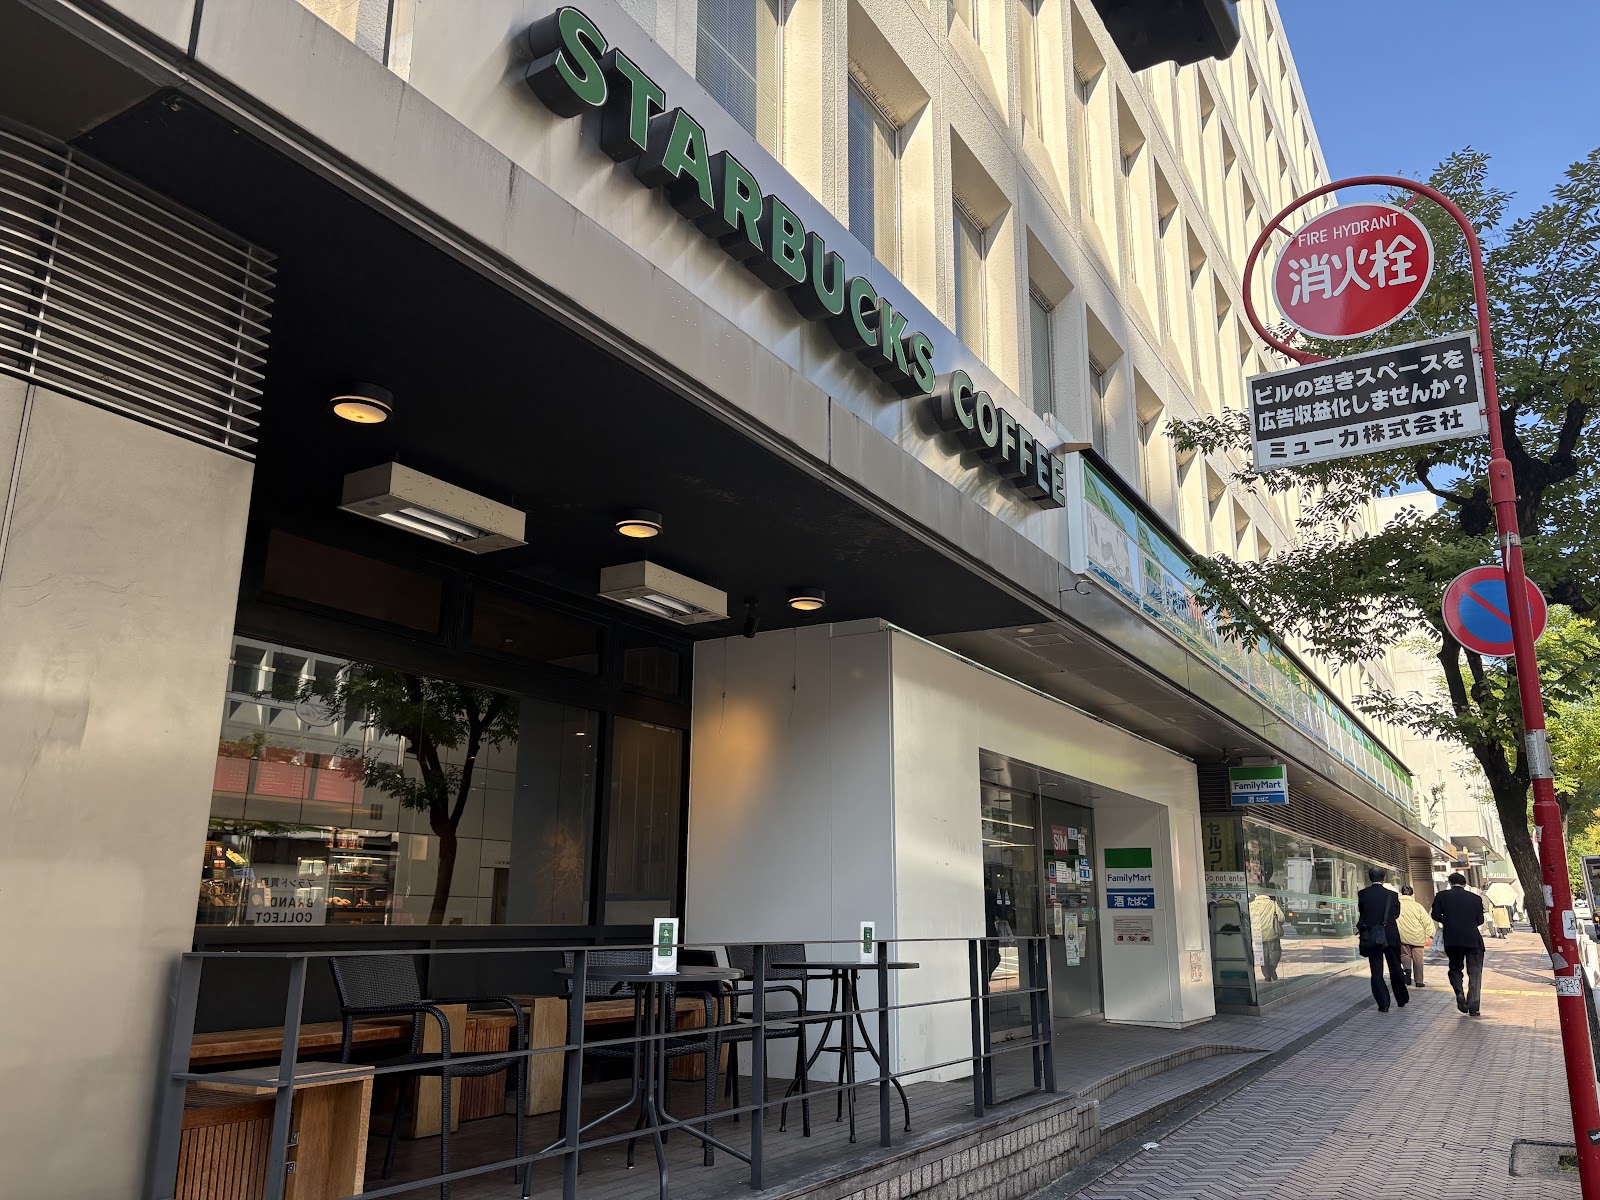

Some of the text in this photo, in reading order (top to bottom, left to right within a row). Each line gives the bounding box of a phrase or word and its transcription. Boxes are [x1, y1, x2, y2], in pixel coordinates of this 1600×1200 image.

[1297, 212, 1399, 248] FIRE HYDRANT
[549, 6, 1066, 507] STARBUCKS COFFEE
[1287, 234, 1418, 307] 消火栓
[1255, 349, 1465, 406] ビルの空きスペースを
[1258, 374, 1469, 432] 広告収益化しませんか?
[1269, 408, 1464, 459] ミューカ株式会社
[1234, 780, 1281, 790] FamilyMart
[1053, 834, 1068, 851] SIM
[1107, 873, 1152, 883] FamilyMart
[1205, 873, 1246, 882] Do not enter
[1114, 895, 1148, 907] 酒 たばこ
